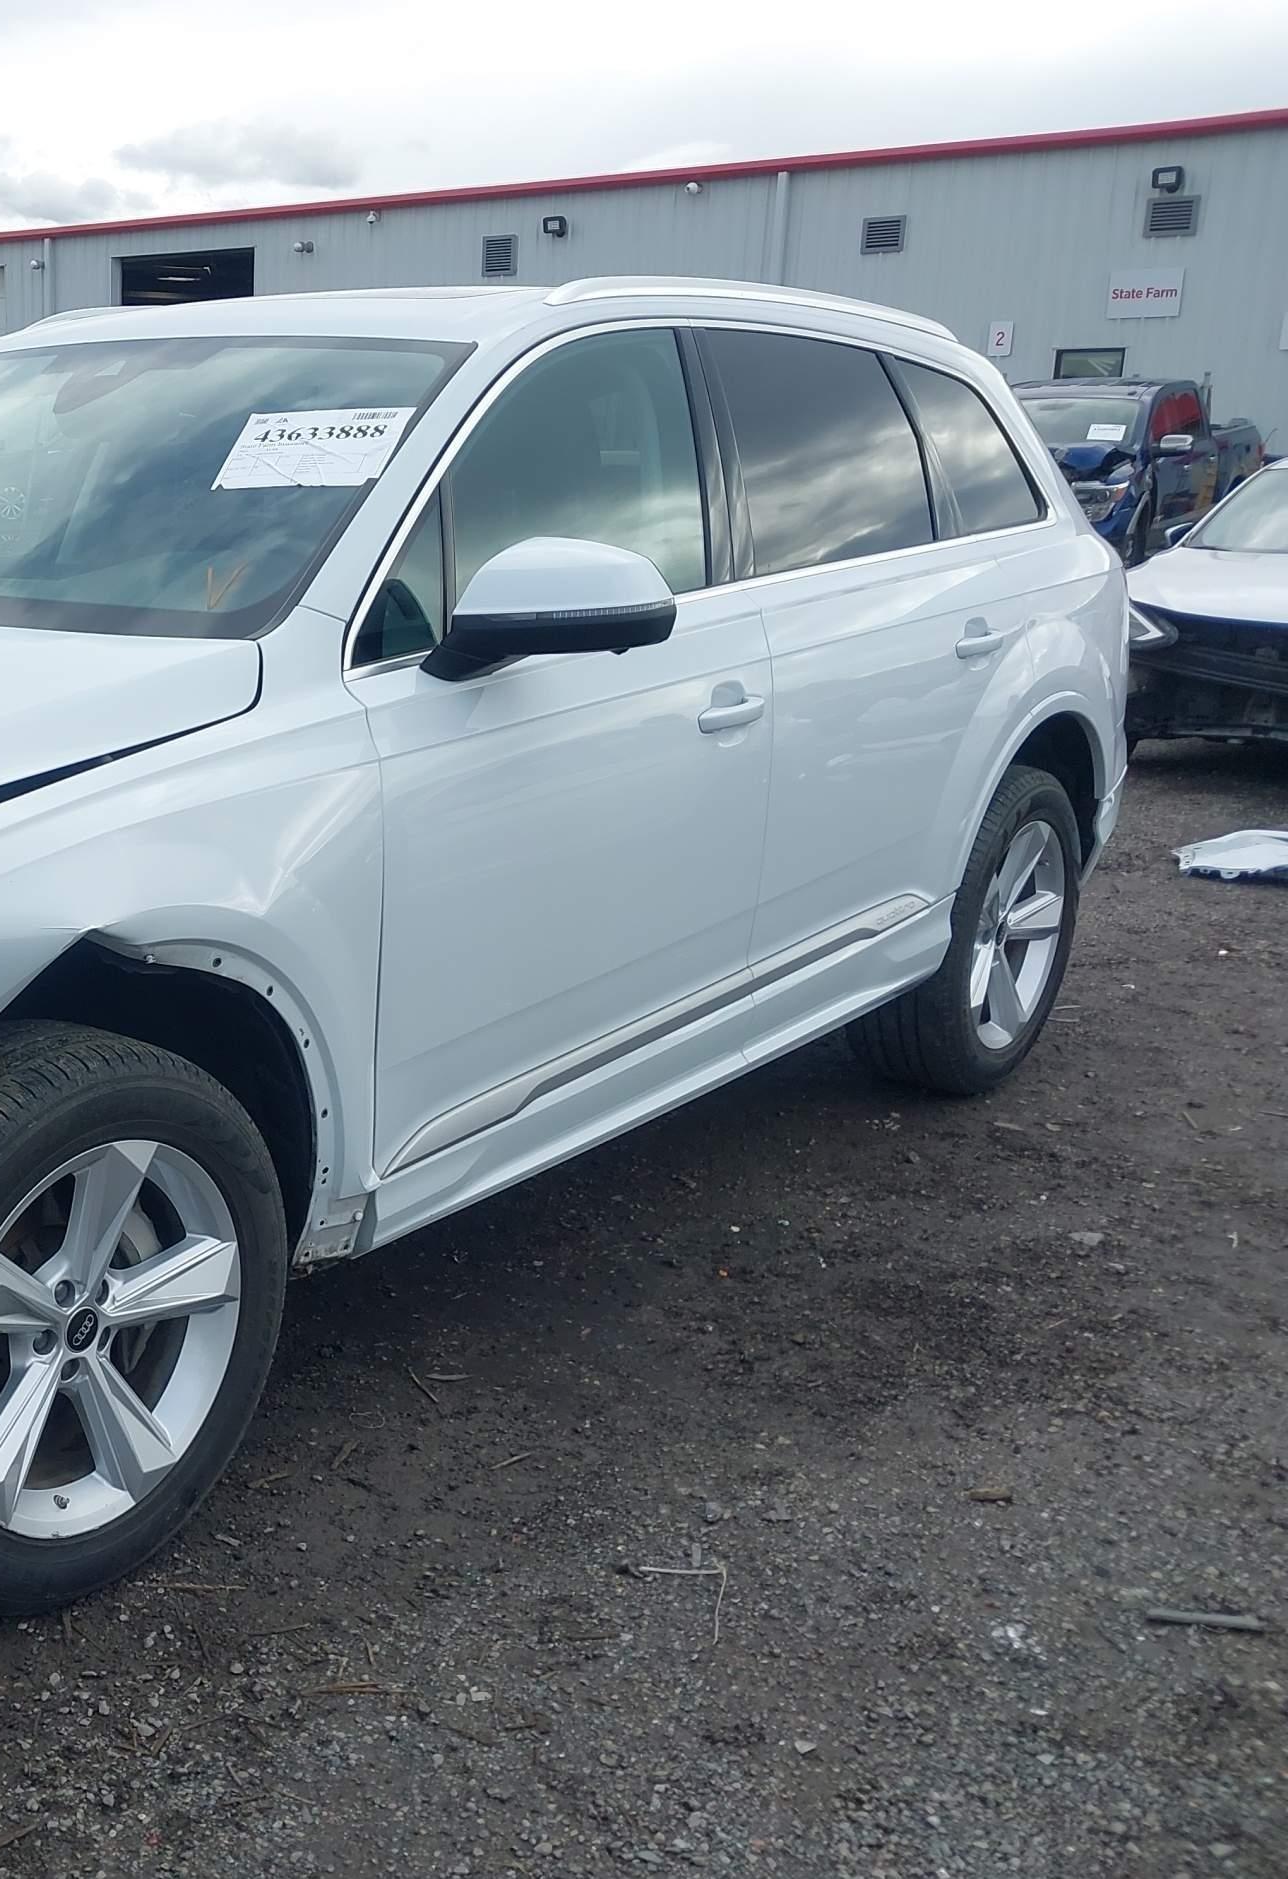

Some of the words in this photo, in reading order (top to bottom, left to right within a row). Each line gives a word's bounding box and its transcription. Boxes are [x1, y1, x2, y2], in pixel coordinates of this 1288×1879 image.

[1112, 288, 1143, 300] State
[1145, 286, 1178, 299] Farm
[995, 331, 1005, 346] 2
[254, 424, 388, 442] 43633888
